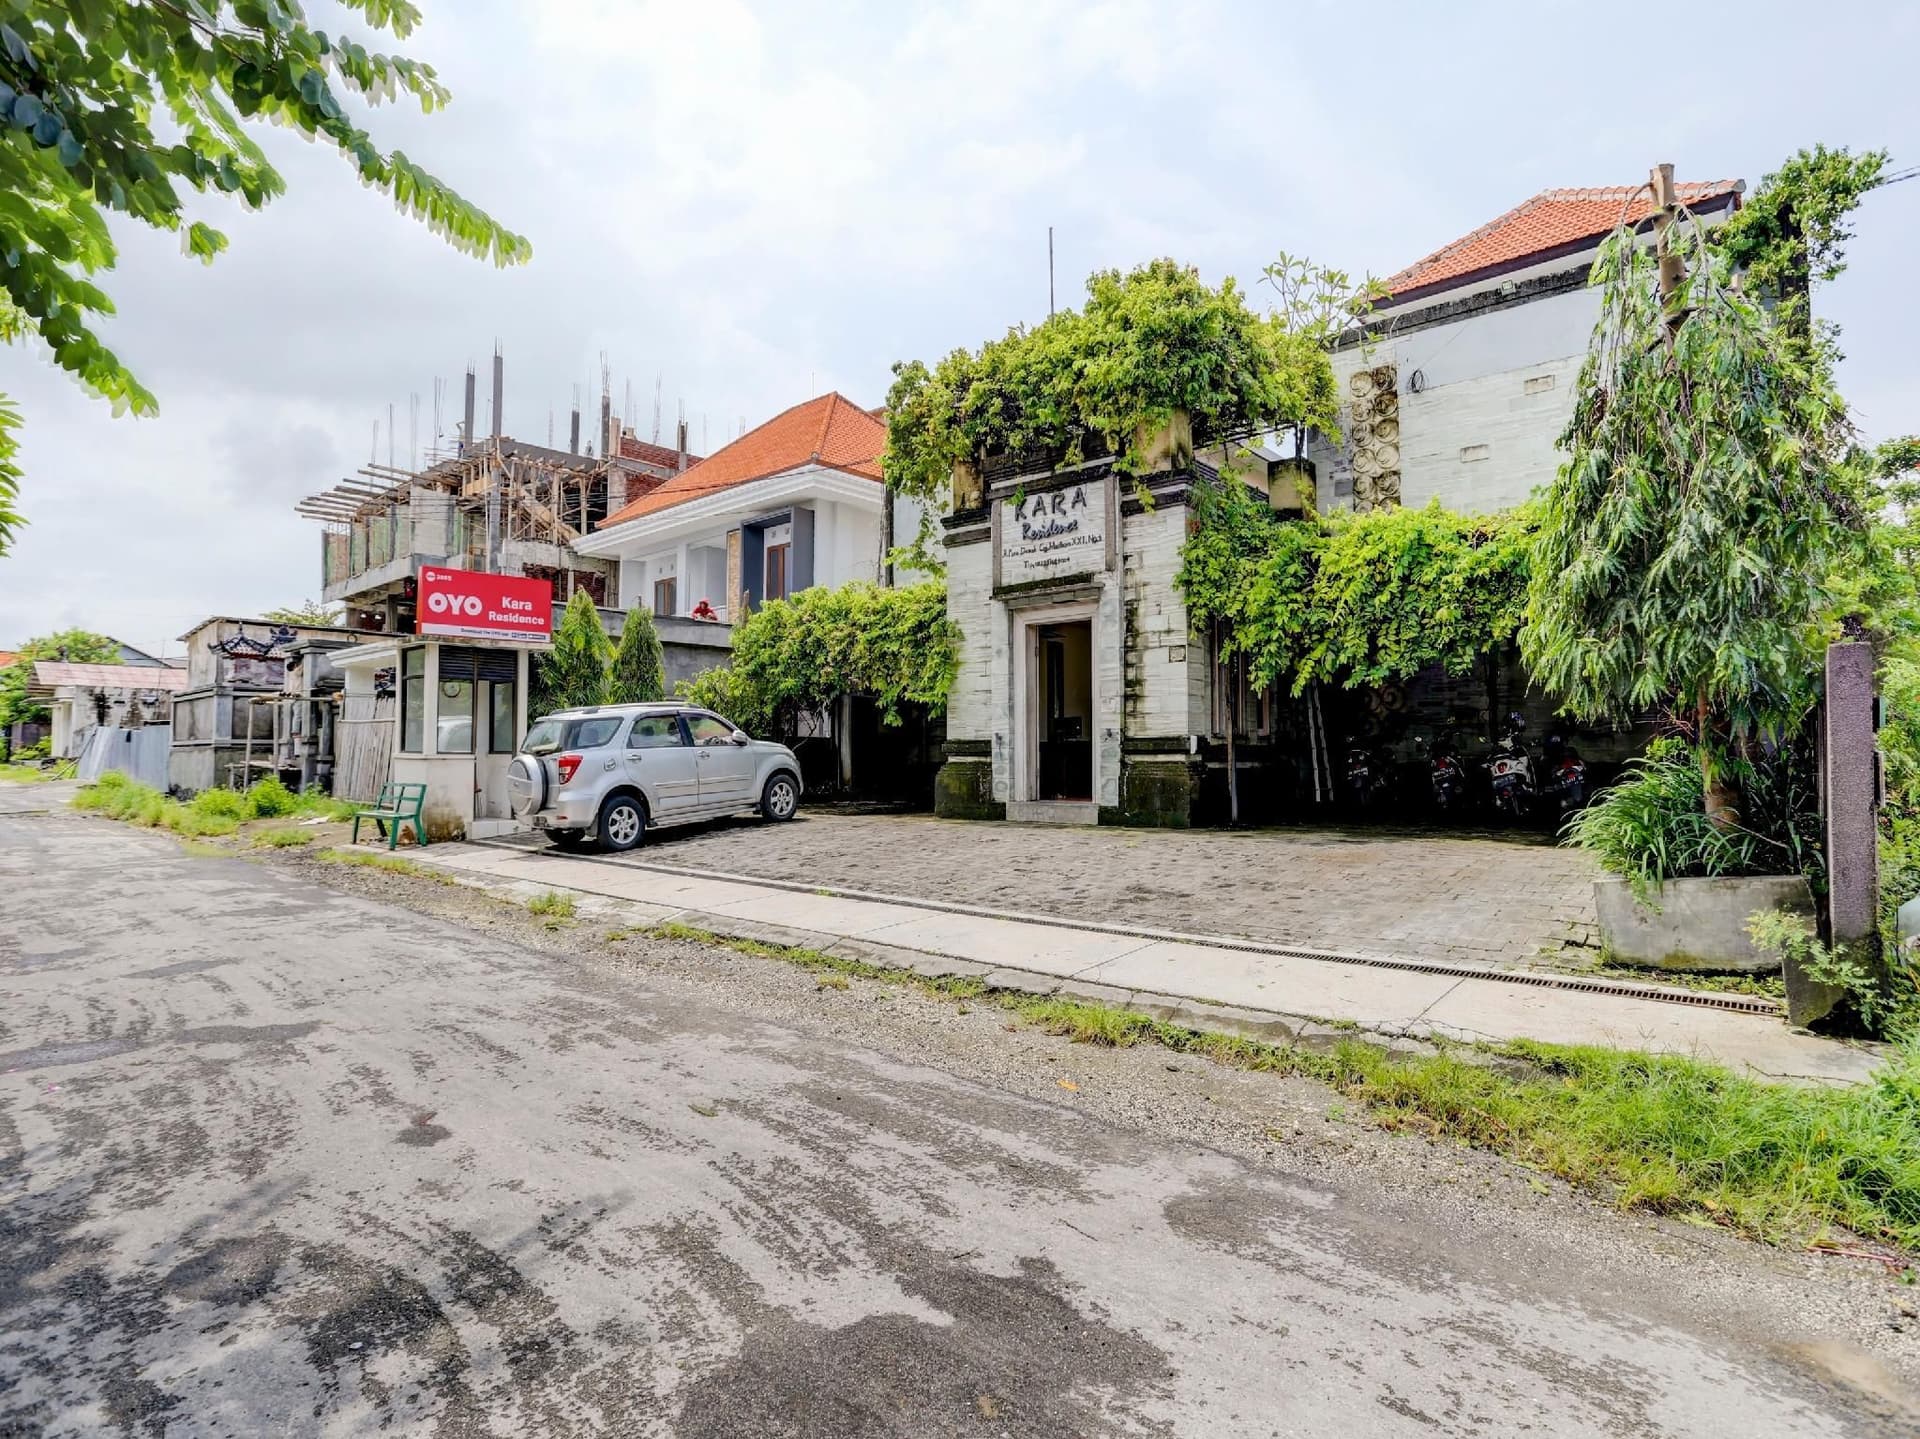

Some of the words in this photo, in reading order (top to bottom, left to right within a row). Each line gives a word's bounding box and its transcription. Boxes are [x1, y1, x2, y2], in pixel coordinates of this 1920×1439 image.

[1015, 487, 1087, 521] KARA
[428, 592, 483, 616] OYO
[502, 596, 533, 611] Kara
[488, 611, 545, 625] Residence
